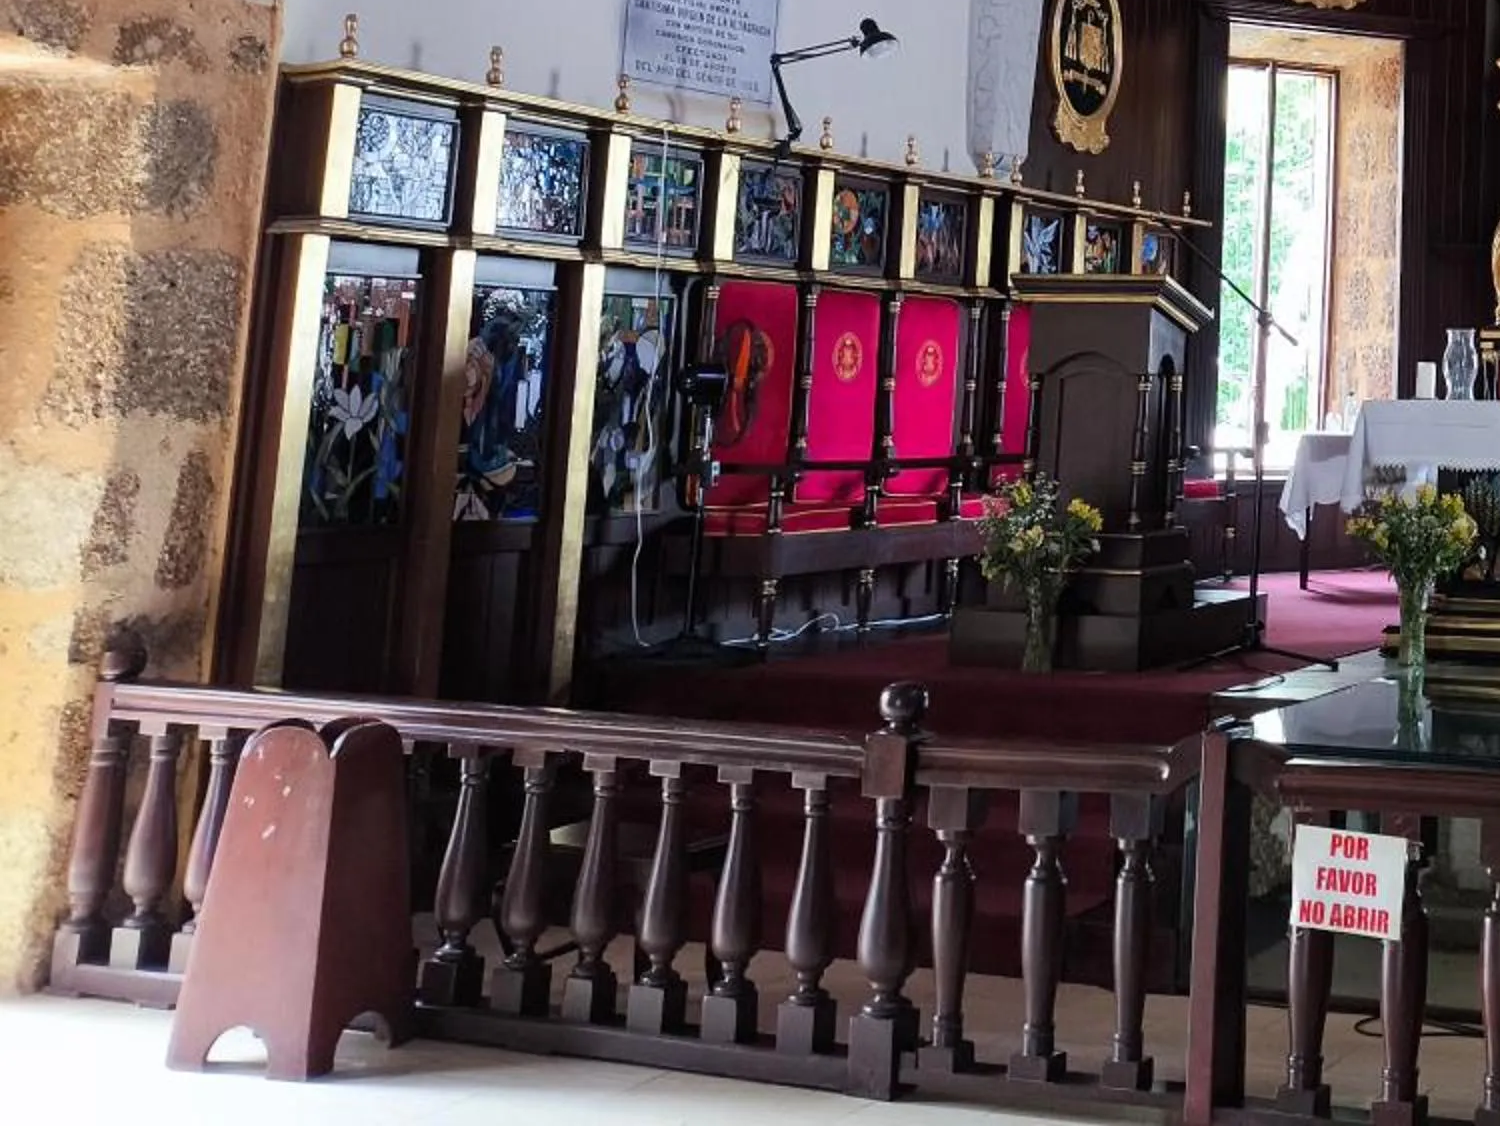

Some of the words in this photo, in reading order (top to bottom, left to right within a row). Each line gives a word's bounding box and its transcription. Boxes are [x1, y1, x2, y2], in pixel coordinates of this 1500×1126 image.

[1330, 833, 1369, 861] POR
[1316, 867, 1377, 897] FAVOR
[1300, 900, 1325, 924] NO
[1329, 903, 1389, 934] ABRIR
